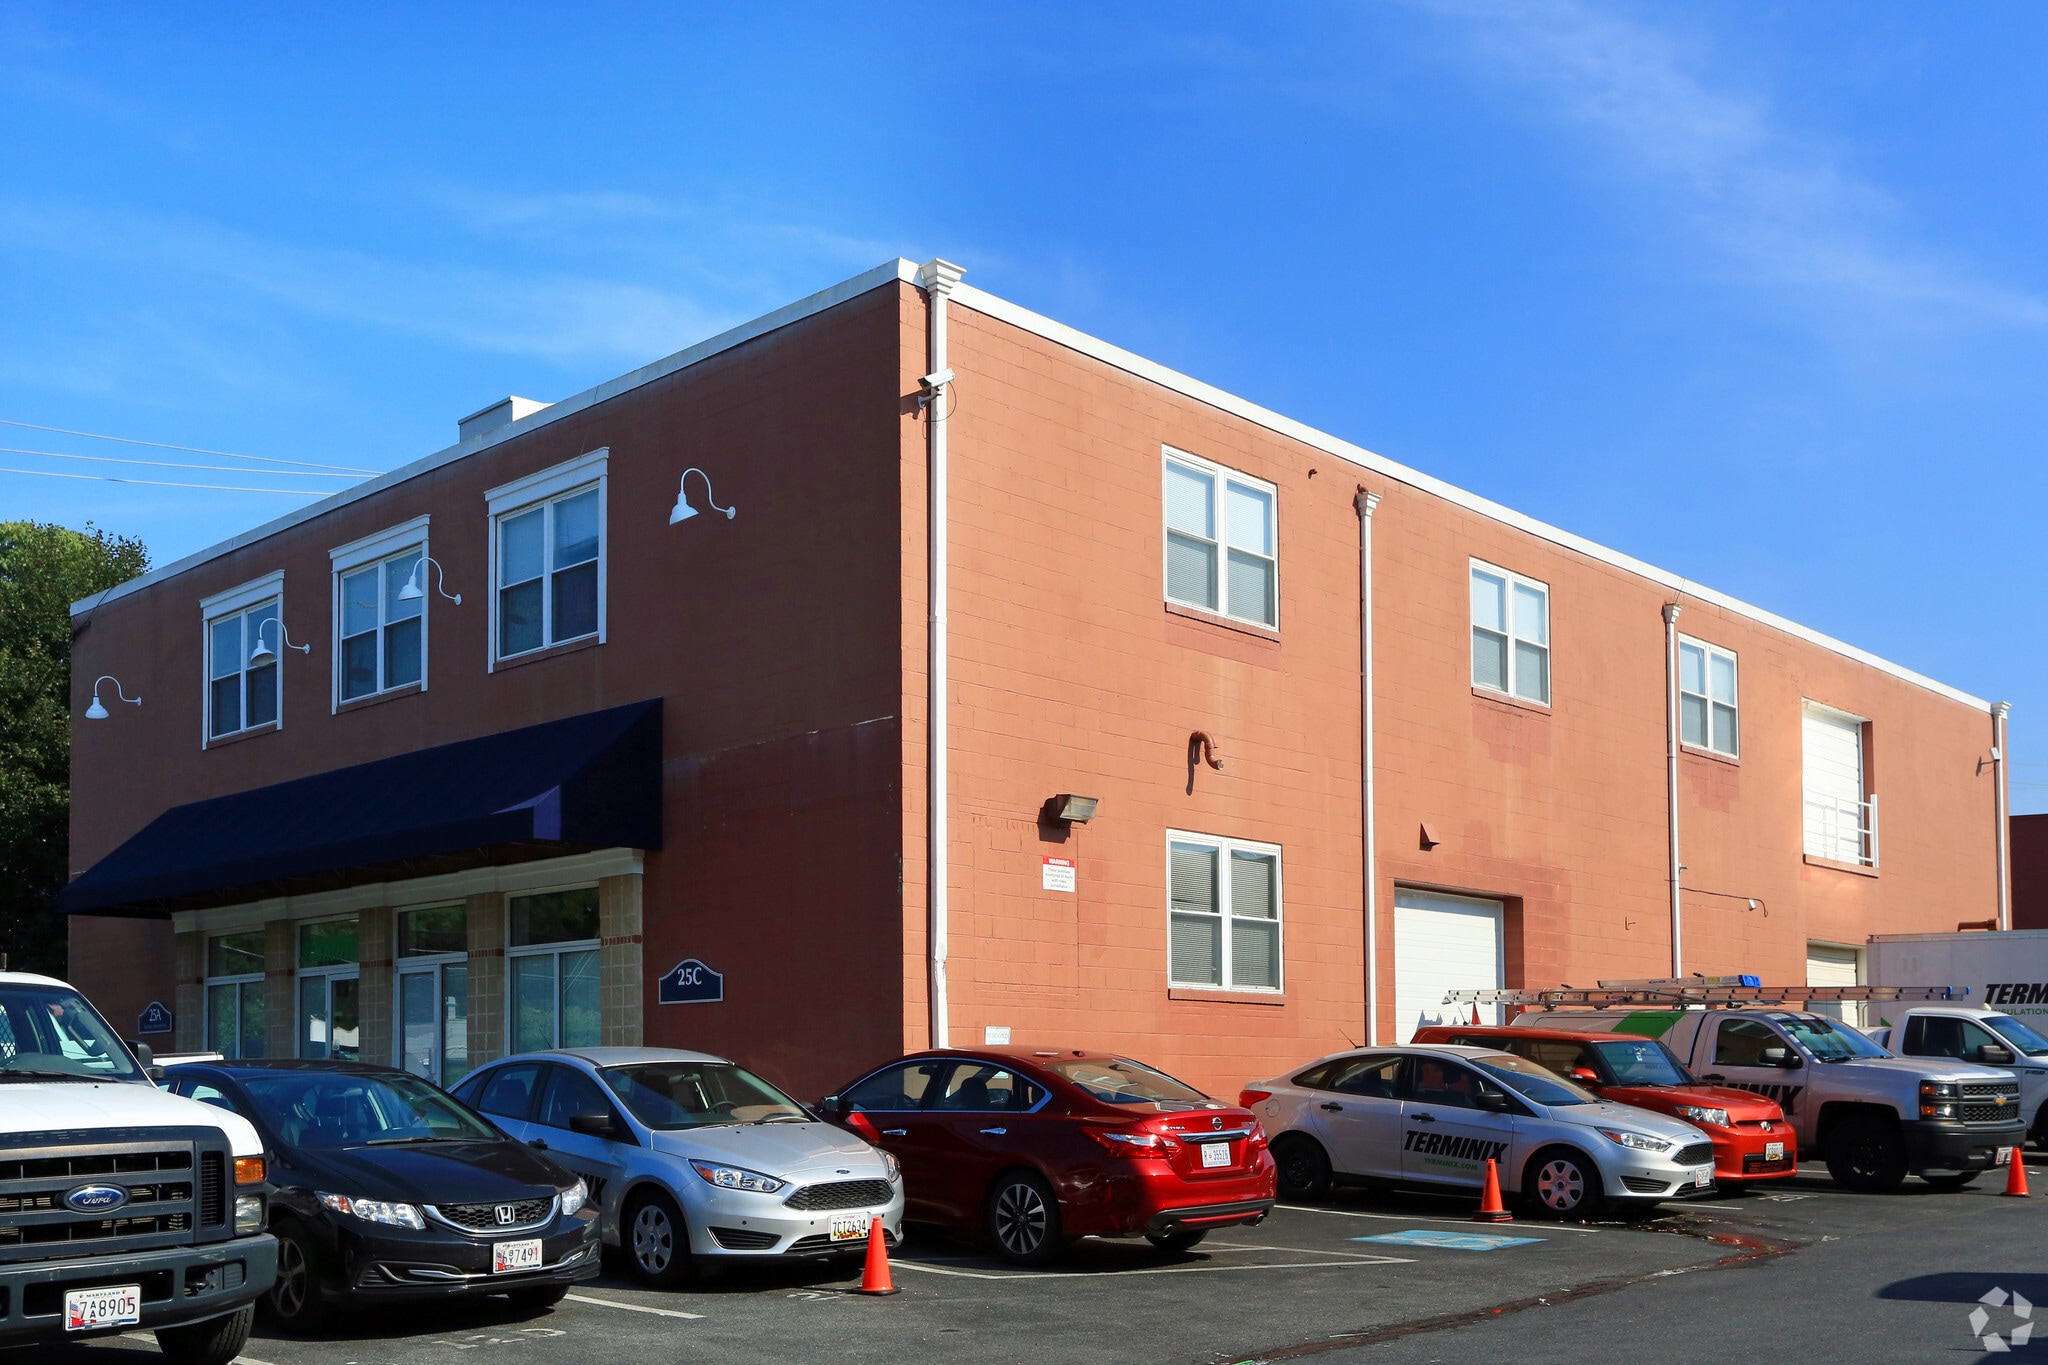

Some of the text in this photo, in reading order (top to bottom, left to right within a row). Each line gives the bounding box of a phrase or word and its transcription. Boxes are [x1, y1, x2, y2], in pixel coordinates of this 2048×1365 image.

[677, 966, 702, 986] 25C
[149, 1008, 162, 1022] 25A
[1993, 1007, 2048, 1015] SULATION
[1404, 1130, 1509, 1164] TERMINIX
[1424, 1157, 1479, 1171] TERMINIX.COM
